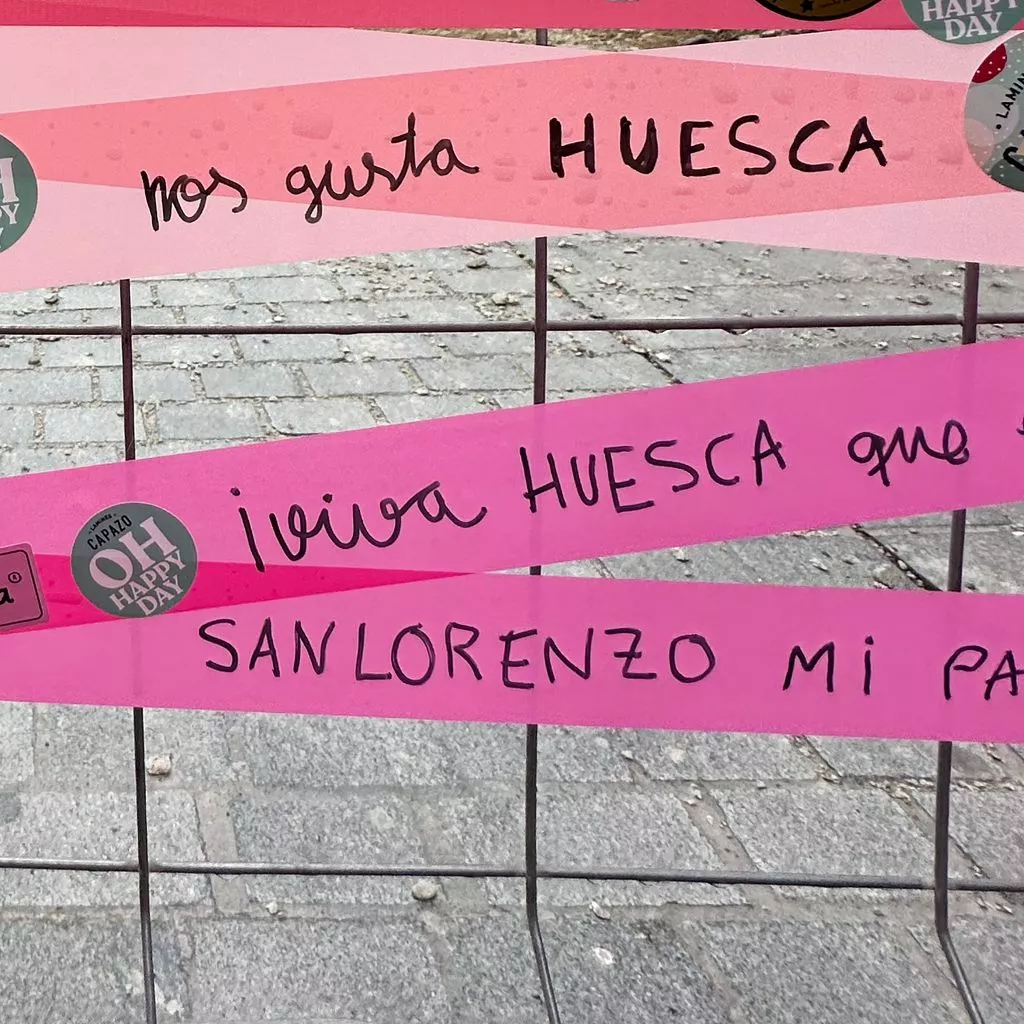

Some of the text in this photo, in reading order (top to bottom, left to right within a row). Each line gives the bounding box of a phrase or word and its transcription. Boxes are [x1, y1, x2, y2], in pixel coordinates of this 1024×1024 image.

[944, 12, 1002, 41] DAY
[141, 113, 887, 231] nos gusta HUESCA
[520, 420, 786, 513] HUESCA
[848, 420, 970, 487] que
[88, 515, 133, 550] CAPAZO
[89, 516, 177, 589] OH
[109, 550, 186, 611] HAPPY
[136, 575, 184, 616] DAY
